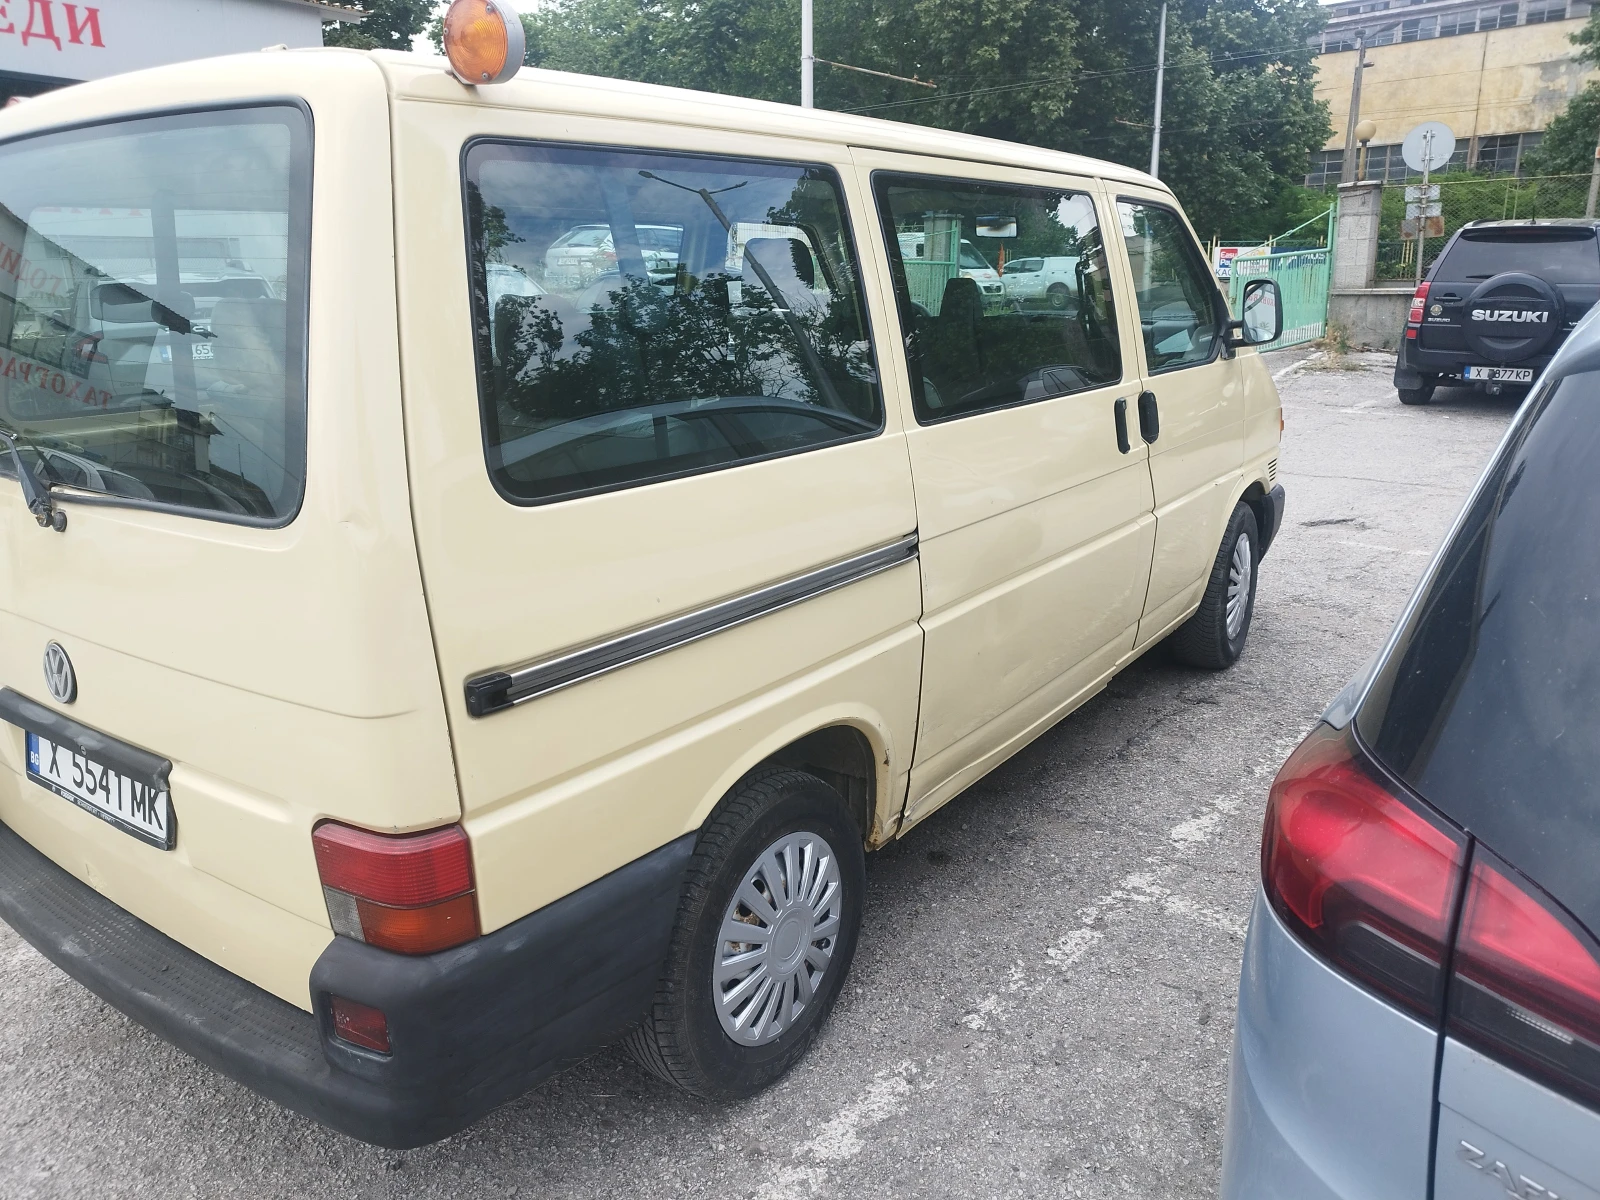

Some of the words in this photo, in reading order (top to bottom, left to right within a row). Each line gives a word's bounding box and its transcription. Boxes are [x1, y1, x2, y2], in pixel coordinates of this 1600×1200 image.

[1471, 309, 1549, 323] SUZUKI
[1487, 369, 1514, 379] 877
[1515, 370, 1531, 380] KP
[72, 751, 123, 811] 5541
[1456, 1140, 1559, 1200] ZAF
